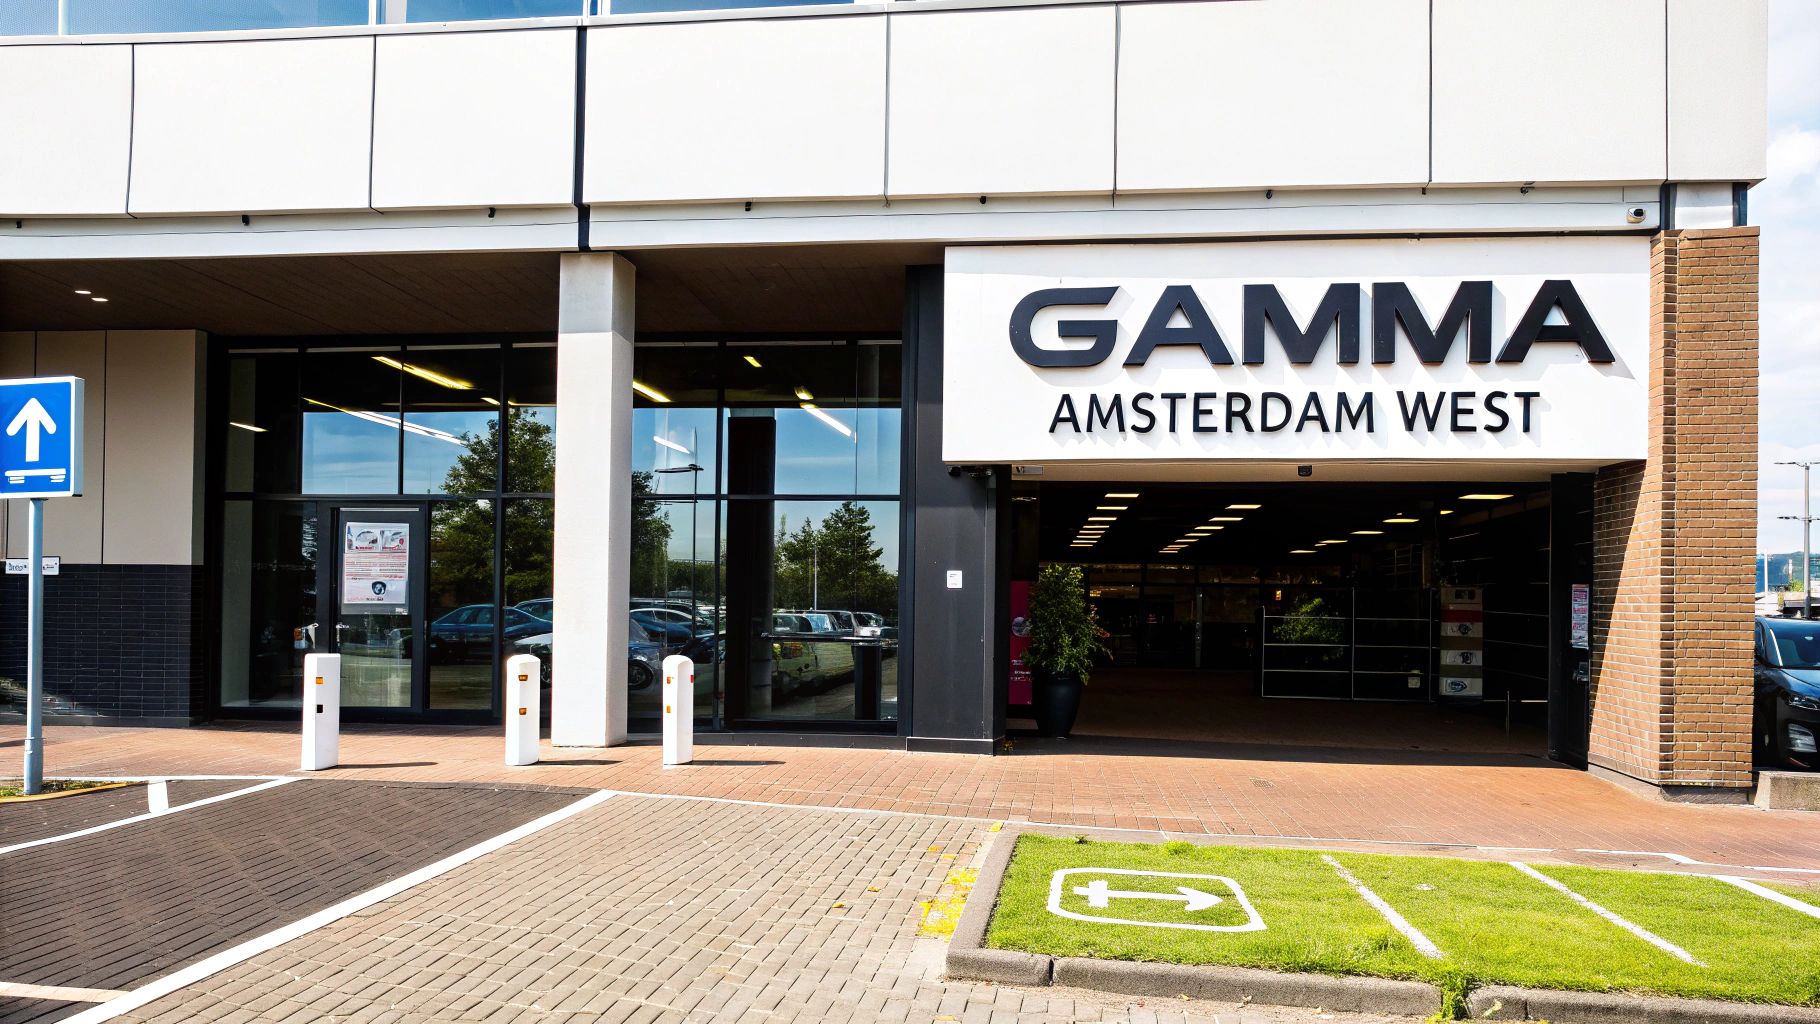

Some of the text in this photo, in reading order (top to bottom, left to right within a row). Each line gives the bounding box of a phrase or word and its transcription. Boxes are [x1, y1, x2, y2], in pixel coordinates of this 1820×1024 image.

[1009, 279, 1616, 369] GAMMA
[1048, 390, 1541, 434] AMSTERDAM WEST
